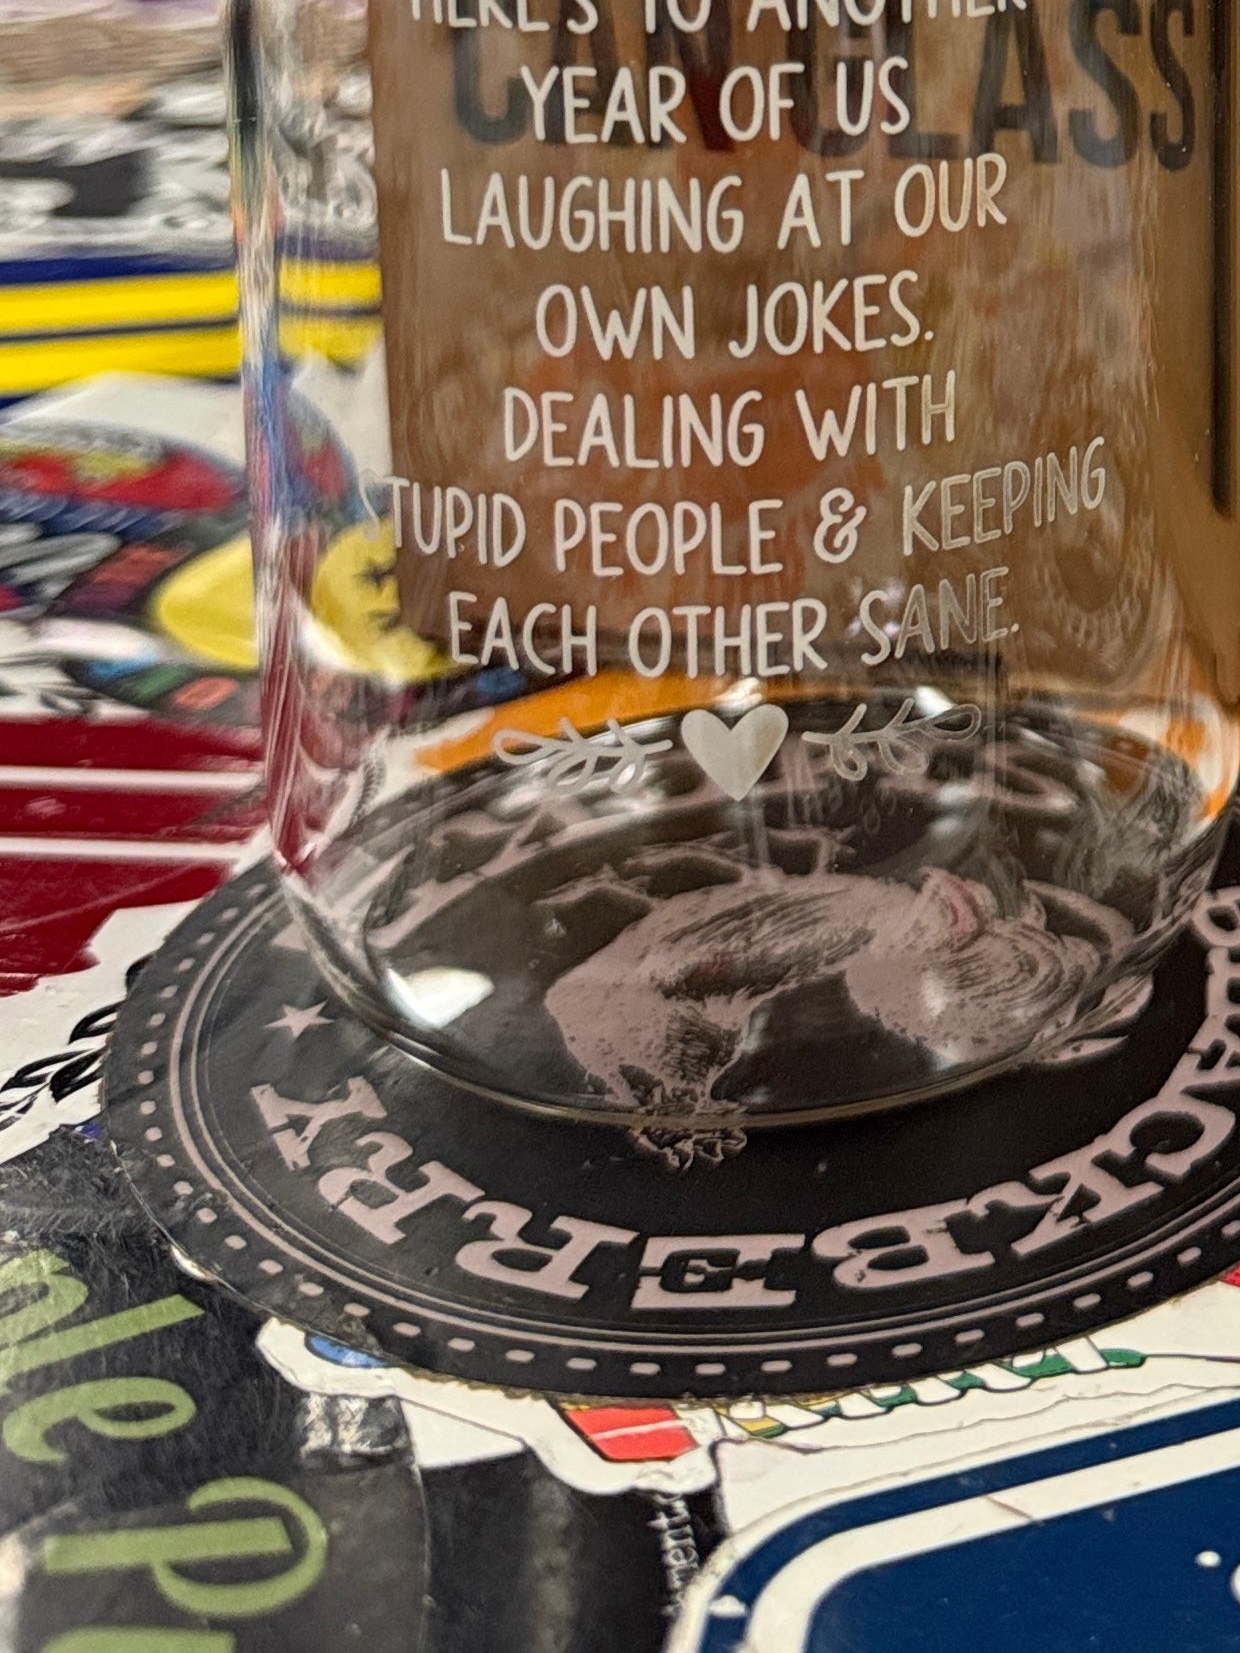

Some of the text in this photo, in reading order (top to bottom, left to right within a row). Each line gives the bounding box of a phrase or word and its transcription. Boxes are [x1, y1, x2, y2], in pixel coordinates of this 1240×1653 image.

[520, 56, 910, 144] YEAR OF US
[440, 152, 1008, 253] LAUGHING AT OUR
[534, 269, 934, 360] OWN JOKES.
[503, 370, 956, 469] DEALING WITH
[554, 496, 783, 578] PEOPLE
[811, 486, 861, 565] &
[902, 435, 1107, 556] KEEPING
[447, 565, 1020, 680] EACH OTHER SANE.
